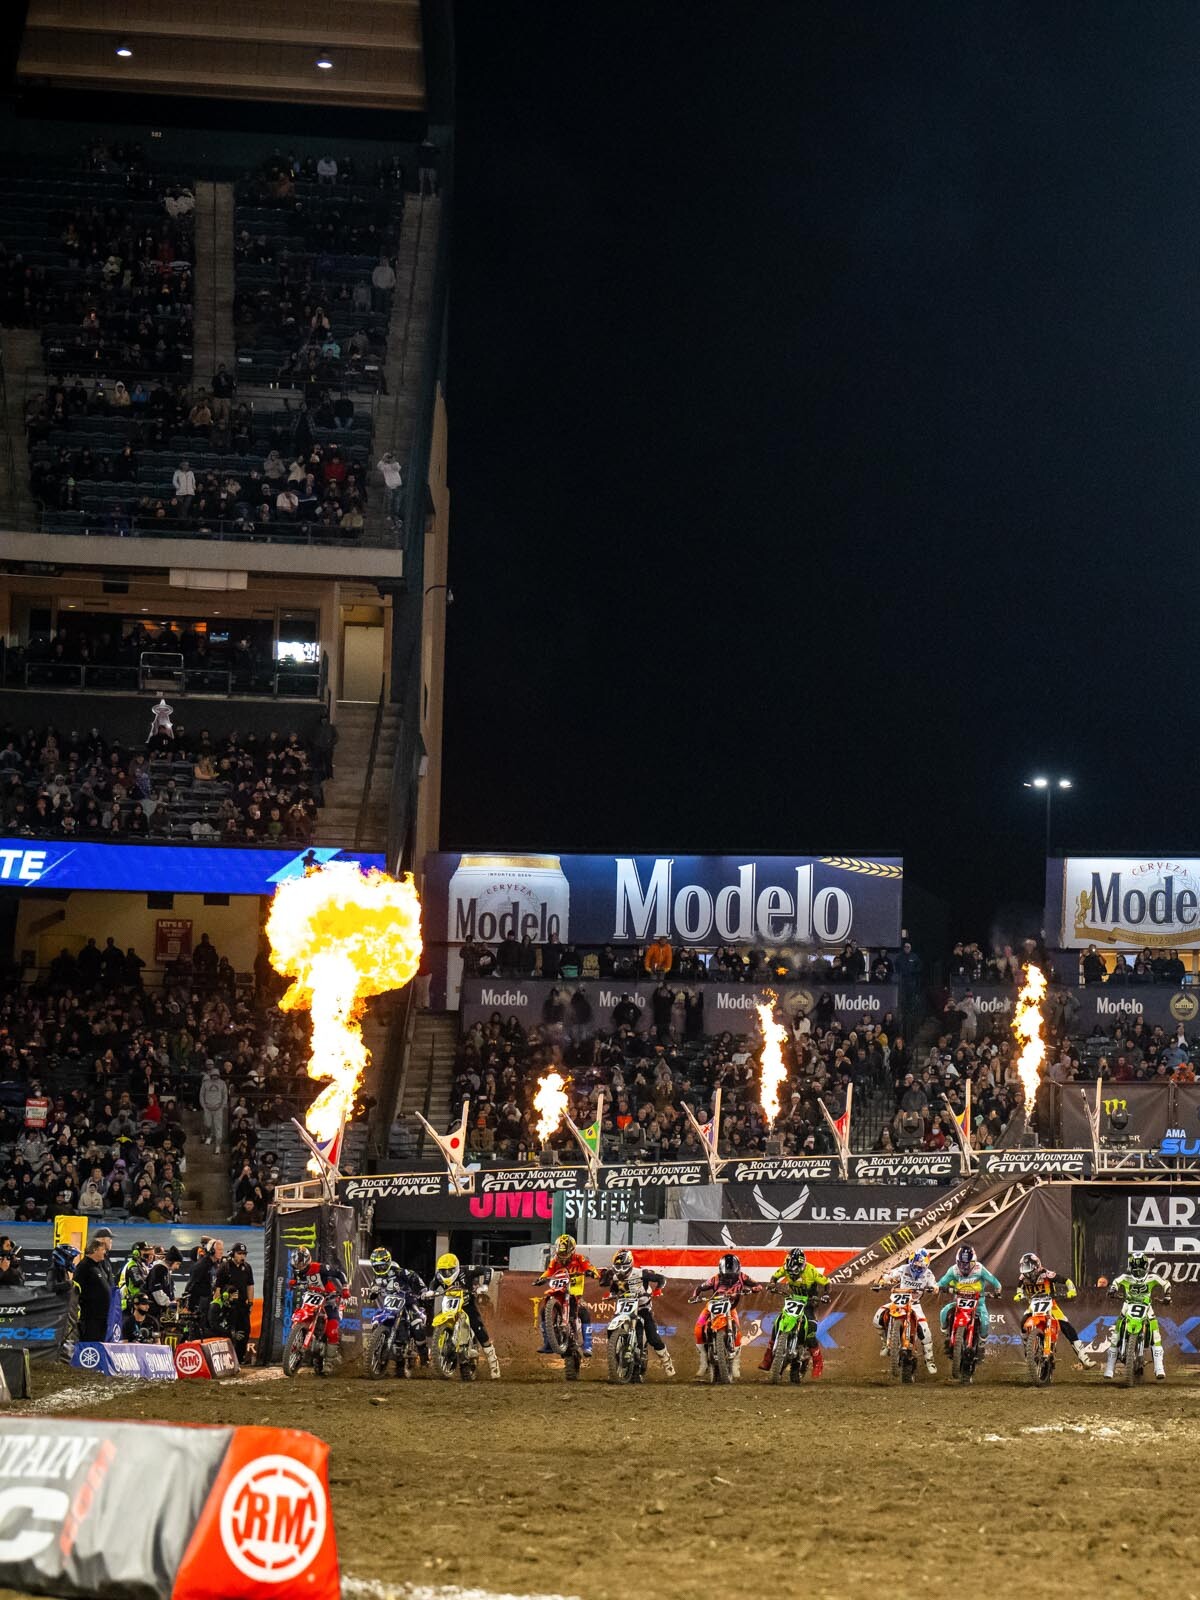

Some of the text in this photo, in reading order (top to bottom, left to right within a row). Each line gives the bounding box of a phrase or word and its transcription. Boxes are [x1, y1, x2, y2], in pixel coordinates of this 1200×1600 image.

[1131, 861, 1188, 877] CERVEZA
[487, 883, 532, 897] CERVEZA
[614, 857, 854, 944] Modelo
[456, 897, 560, 942] Modelo
[481, 989, 528, 1006] Modelo
[834, 994, 881, 1012] Modelo
[1096, 997, 1144, 1015] Modelo
[1166, 1128, 1186, 1139] AMA
[870, 1154, 952, 1166] ROCKY MOUNTAIN
[1001, 1152, 1083, 1163] ROCKY MOUNTAIN
[749, 1158, 831, 1170] ROCKY MOUNTAIN
[496, 1169, 576, 1181] ROCKY MOUNTAIN
[620, 1165, 701, 1177] ROCKY MOUNTAIN
[361, 1176, 441, 1188] ROCKY MOUNTAIN
[812, 1206, 850, 1221] U.S.
[854, 1206, 892, 1221] AIR
[304, 1294, 322, 1305] 78
[893, 1294, 911, 1305] 25
[958, 1299, 975, 1308] 54
[619, 1301, 634, 1313] 15
[711, 1303, 728, 1315] 61
[786, 1301, 804, 1315] 21
[1034, 1301, 1050, 1313] 17
[1131, 1304, 1146, 1318] 9
[243, 1492, 312, 1546] RM
